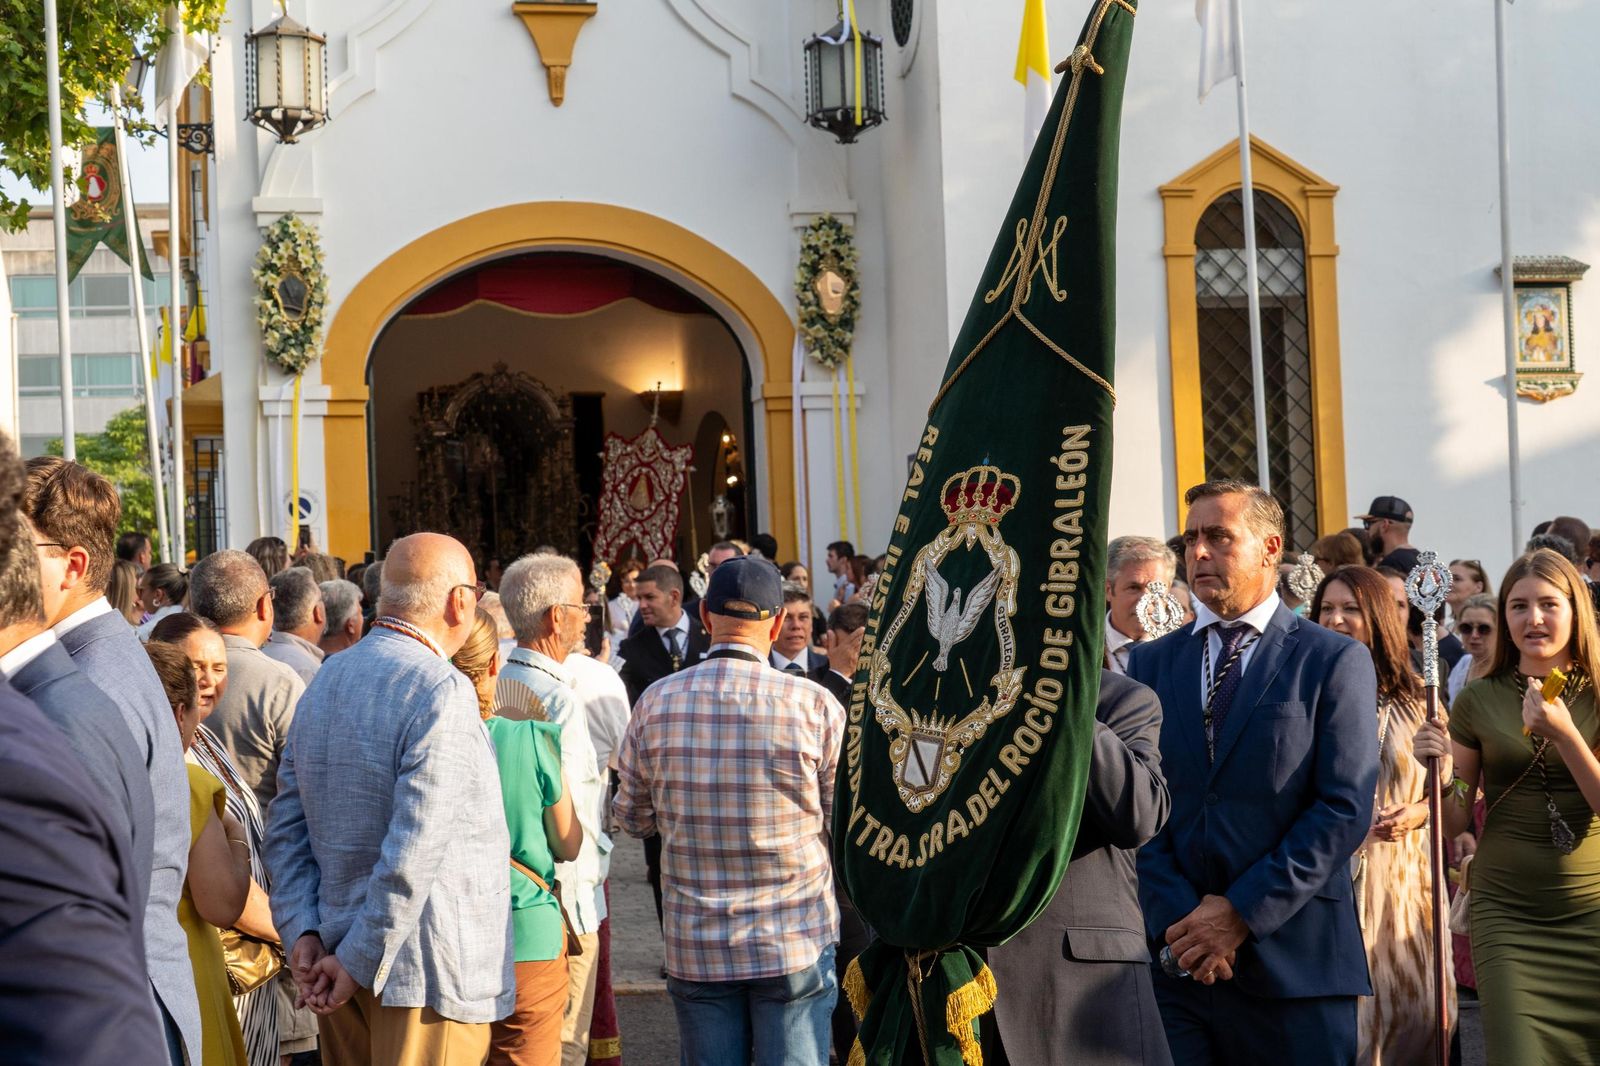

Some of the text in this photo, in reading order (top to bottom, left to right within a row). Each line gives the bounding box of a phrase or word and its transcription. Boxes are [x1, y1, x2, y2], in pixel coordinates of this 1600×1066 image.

[903, 424, 939, 502] REAL
[895, 514, 911, 534] E
[857, 544, 903, 671] ILUSTRE
[997, 606, 1013, 671] GIBRALEON
[1039, 627, 1074, 671] DE
[998, 677, 1064, 776] ROCÍO
